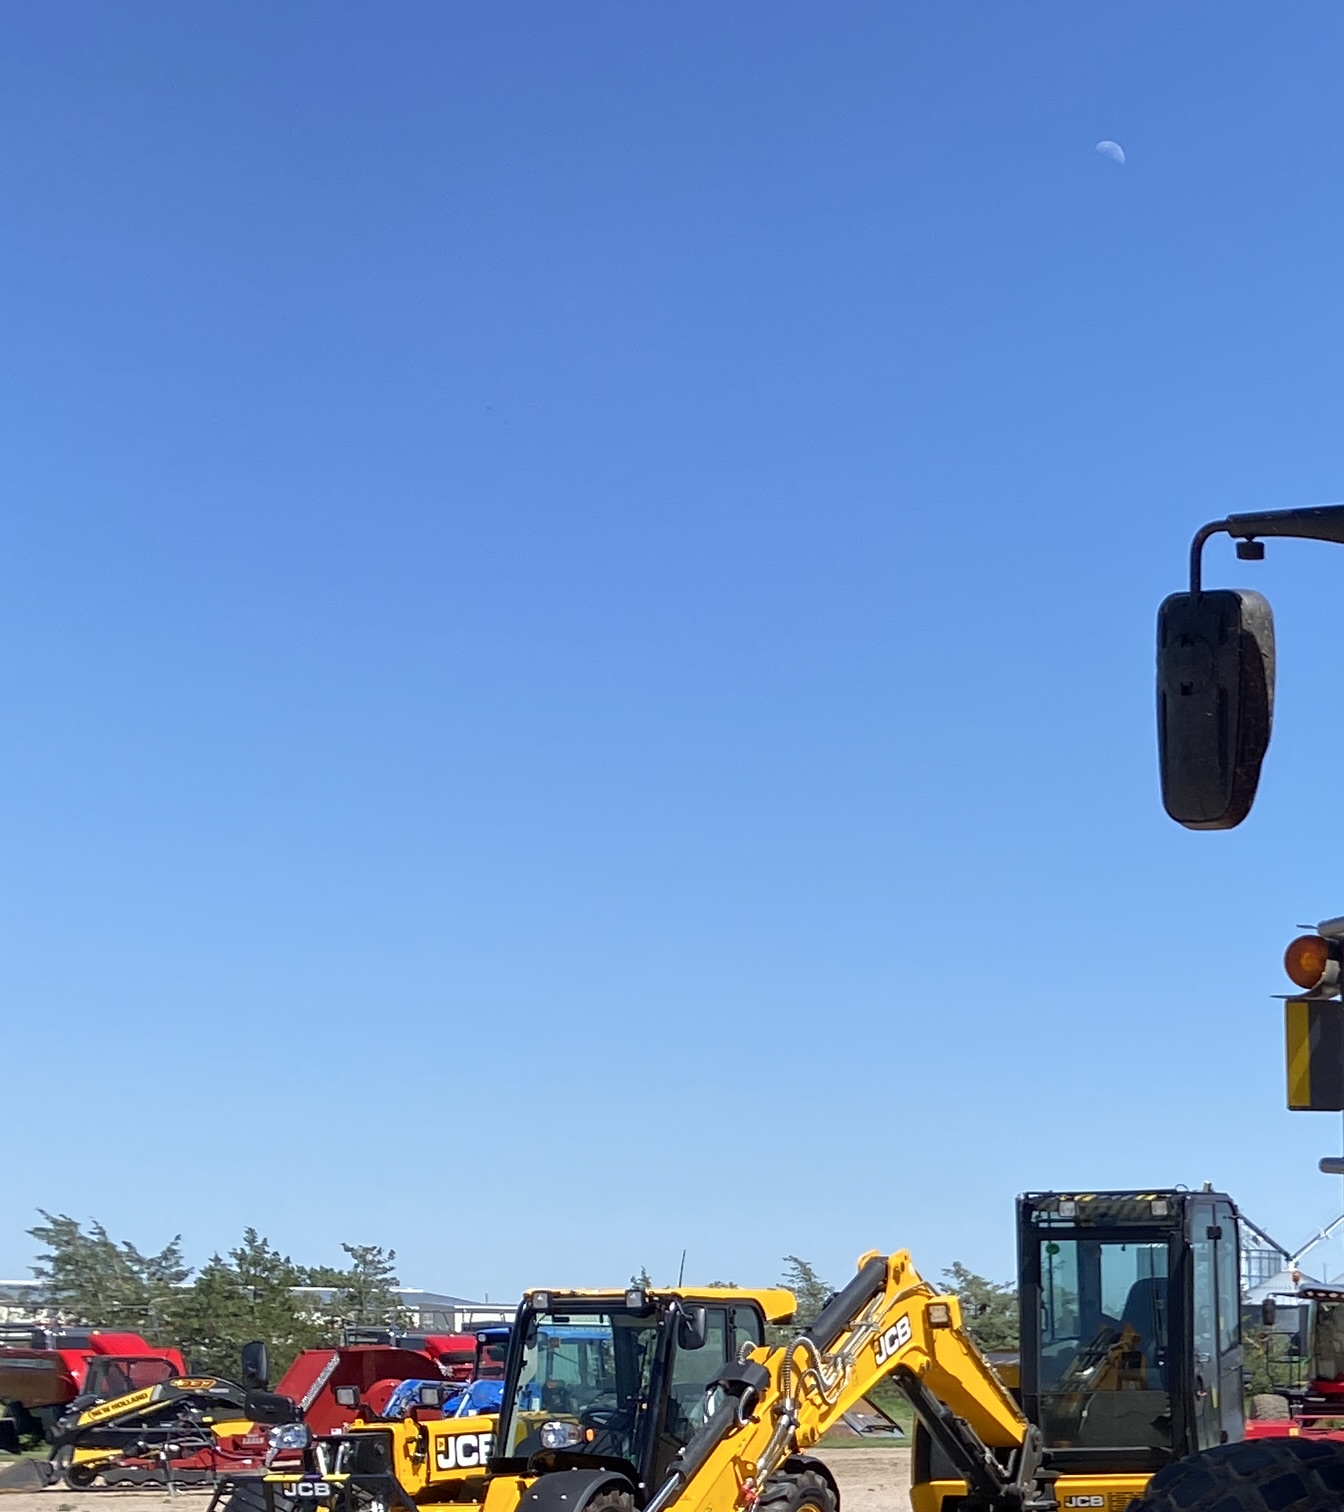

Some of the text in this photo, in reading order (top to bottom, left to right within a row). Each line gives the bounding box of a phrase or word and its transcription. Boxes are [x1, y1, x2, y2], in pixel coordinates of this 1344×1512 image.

[875, 1315, 912, 1365] JCB
[111, 1392, 149, 1411] HOLLAND
[284, 1482, 331, 1497] JCB
[1065, 1495, 1105, 1508] JCB
